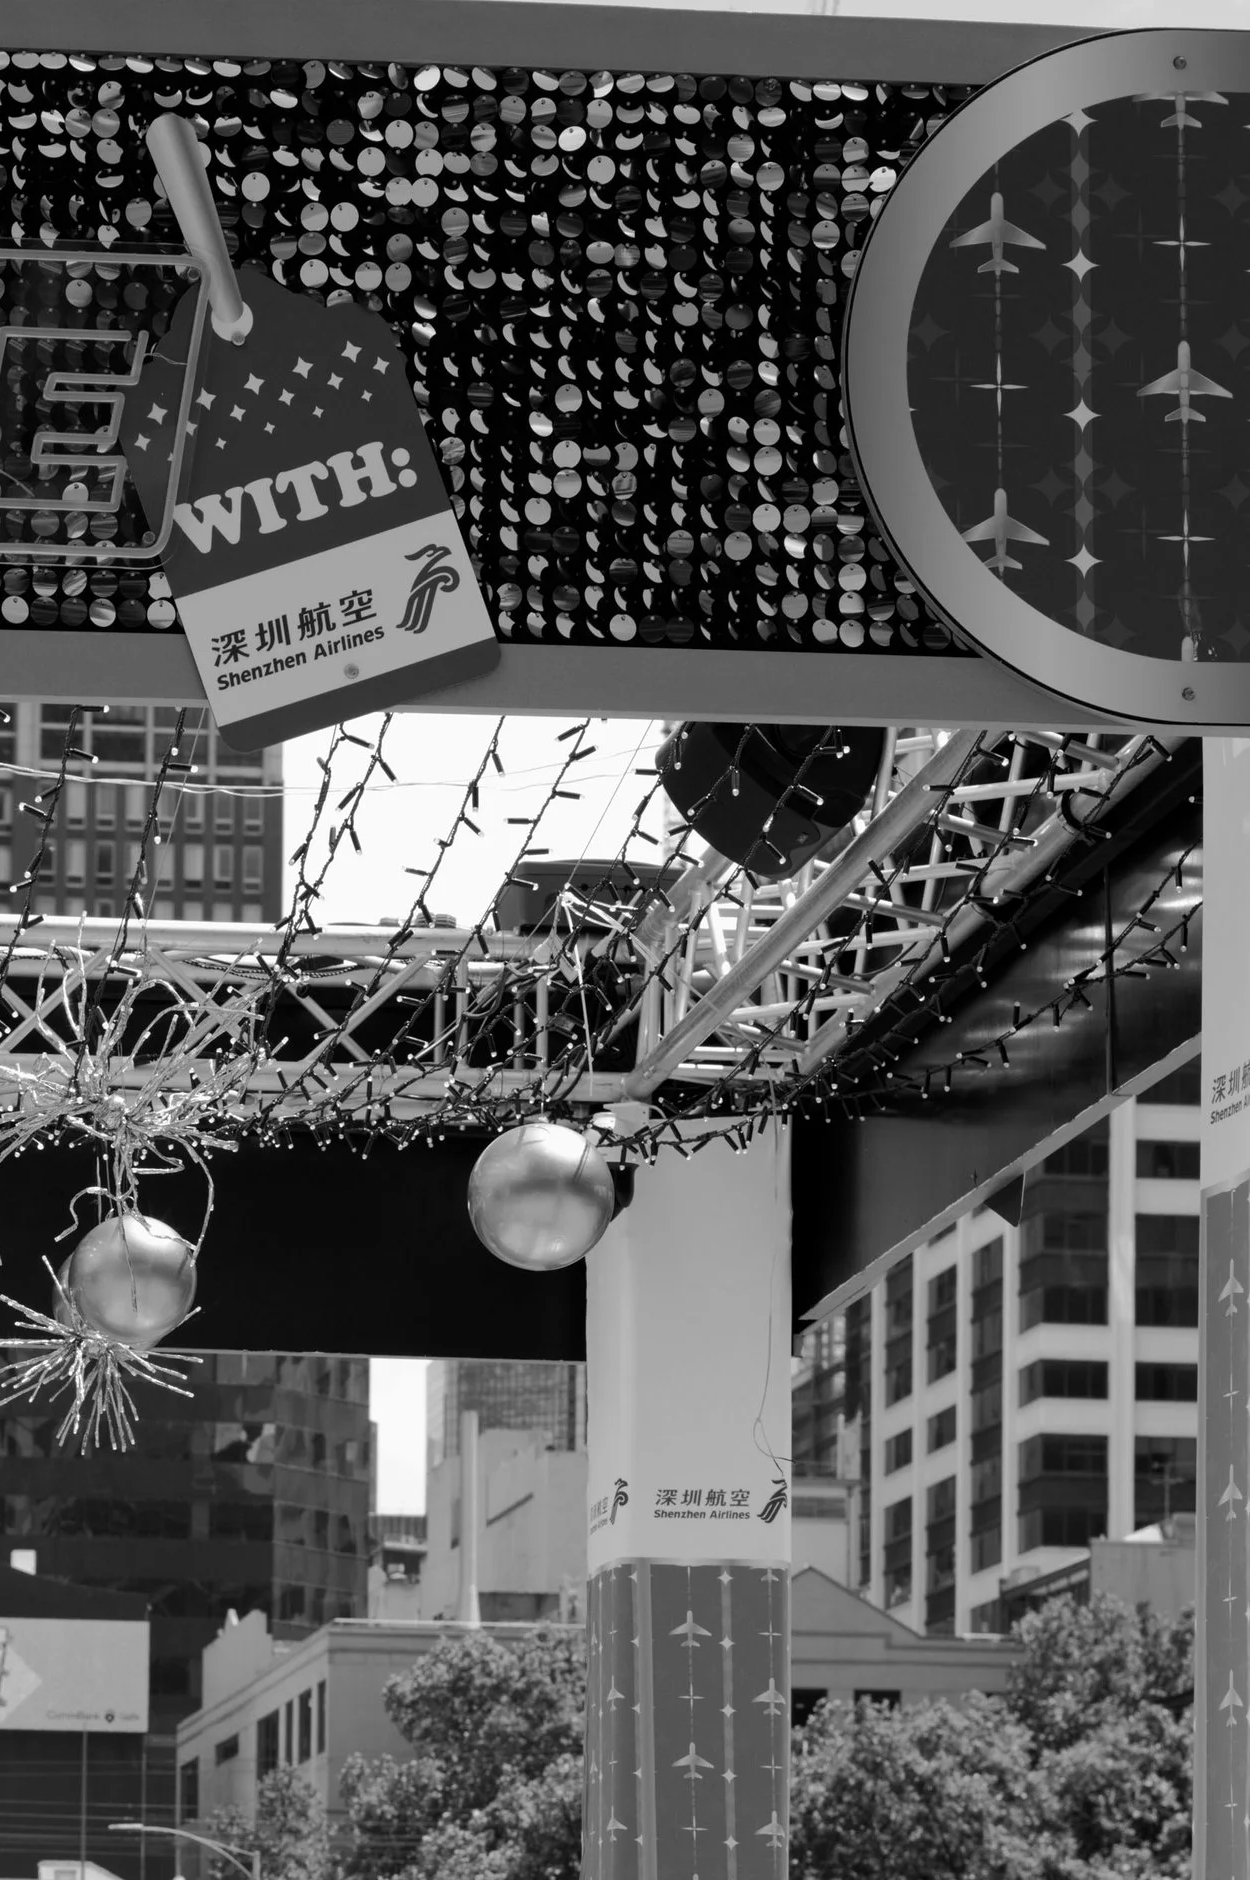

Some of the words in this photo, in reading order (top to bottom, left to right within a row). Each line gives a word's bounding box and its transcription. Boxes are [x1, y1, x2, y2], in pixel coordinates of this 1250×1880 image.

[172, 441, 418, 554] WITH:
[210, 588, 377, 668] 深圳航空
[216, 650, 307, 691] Shenzhen
[313, 625, 385, 661] Airlines
[653, 1509, 707, 1519] Shenzhen
[709, 1509, 751, 1520] Airlines
[655, 1488, 751, 1508] 深圳航空
